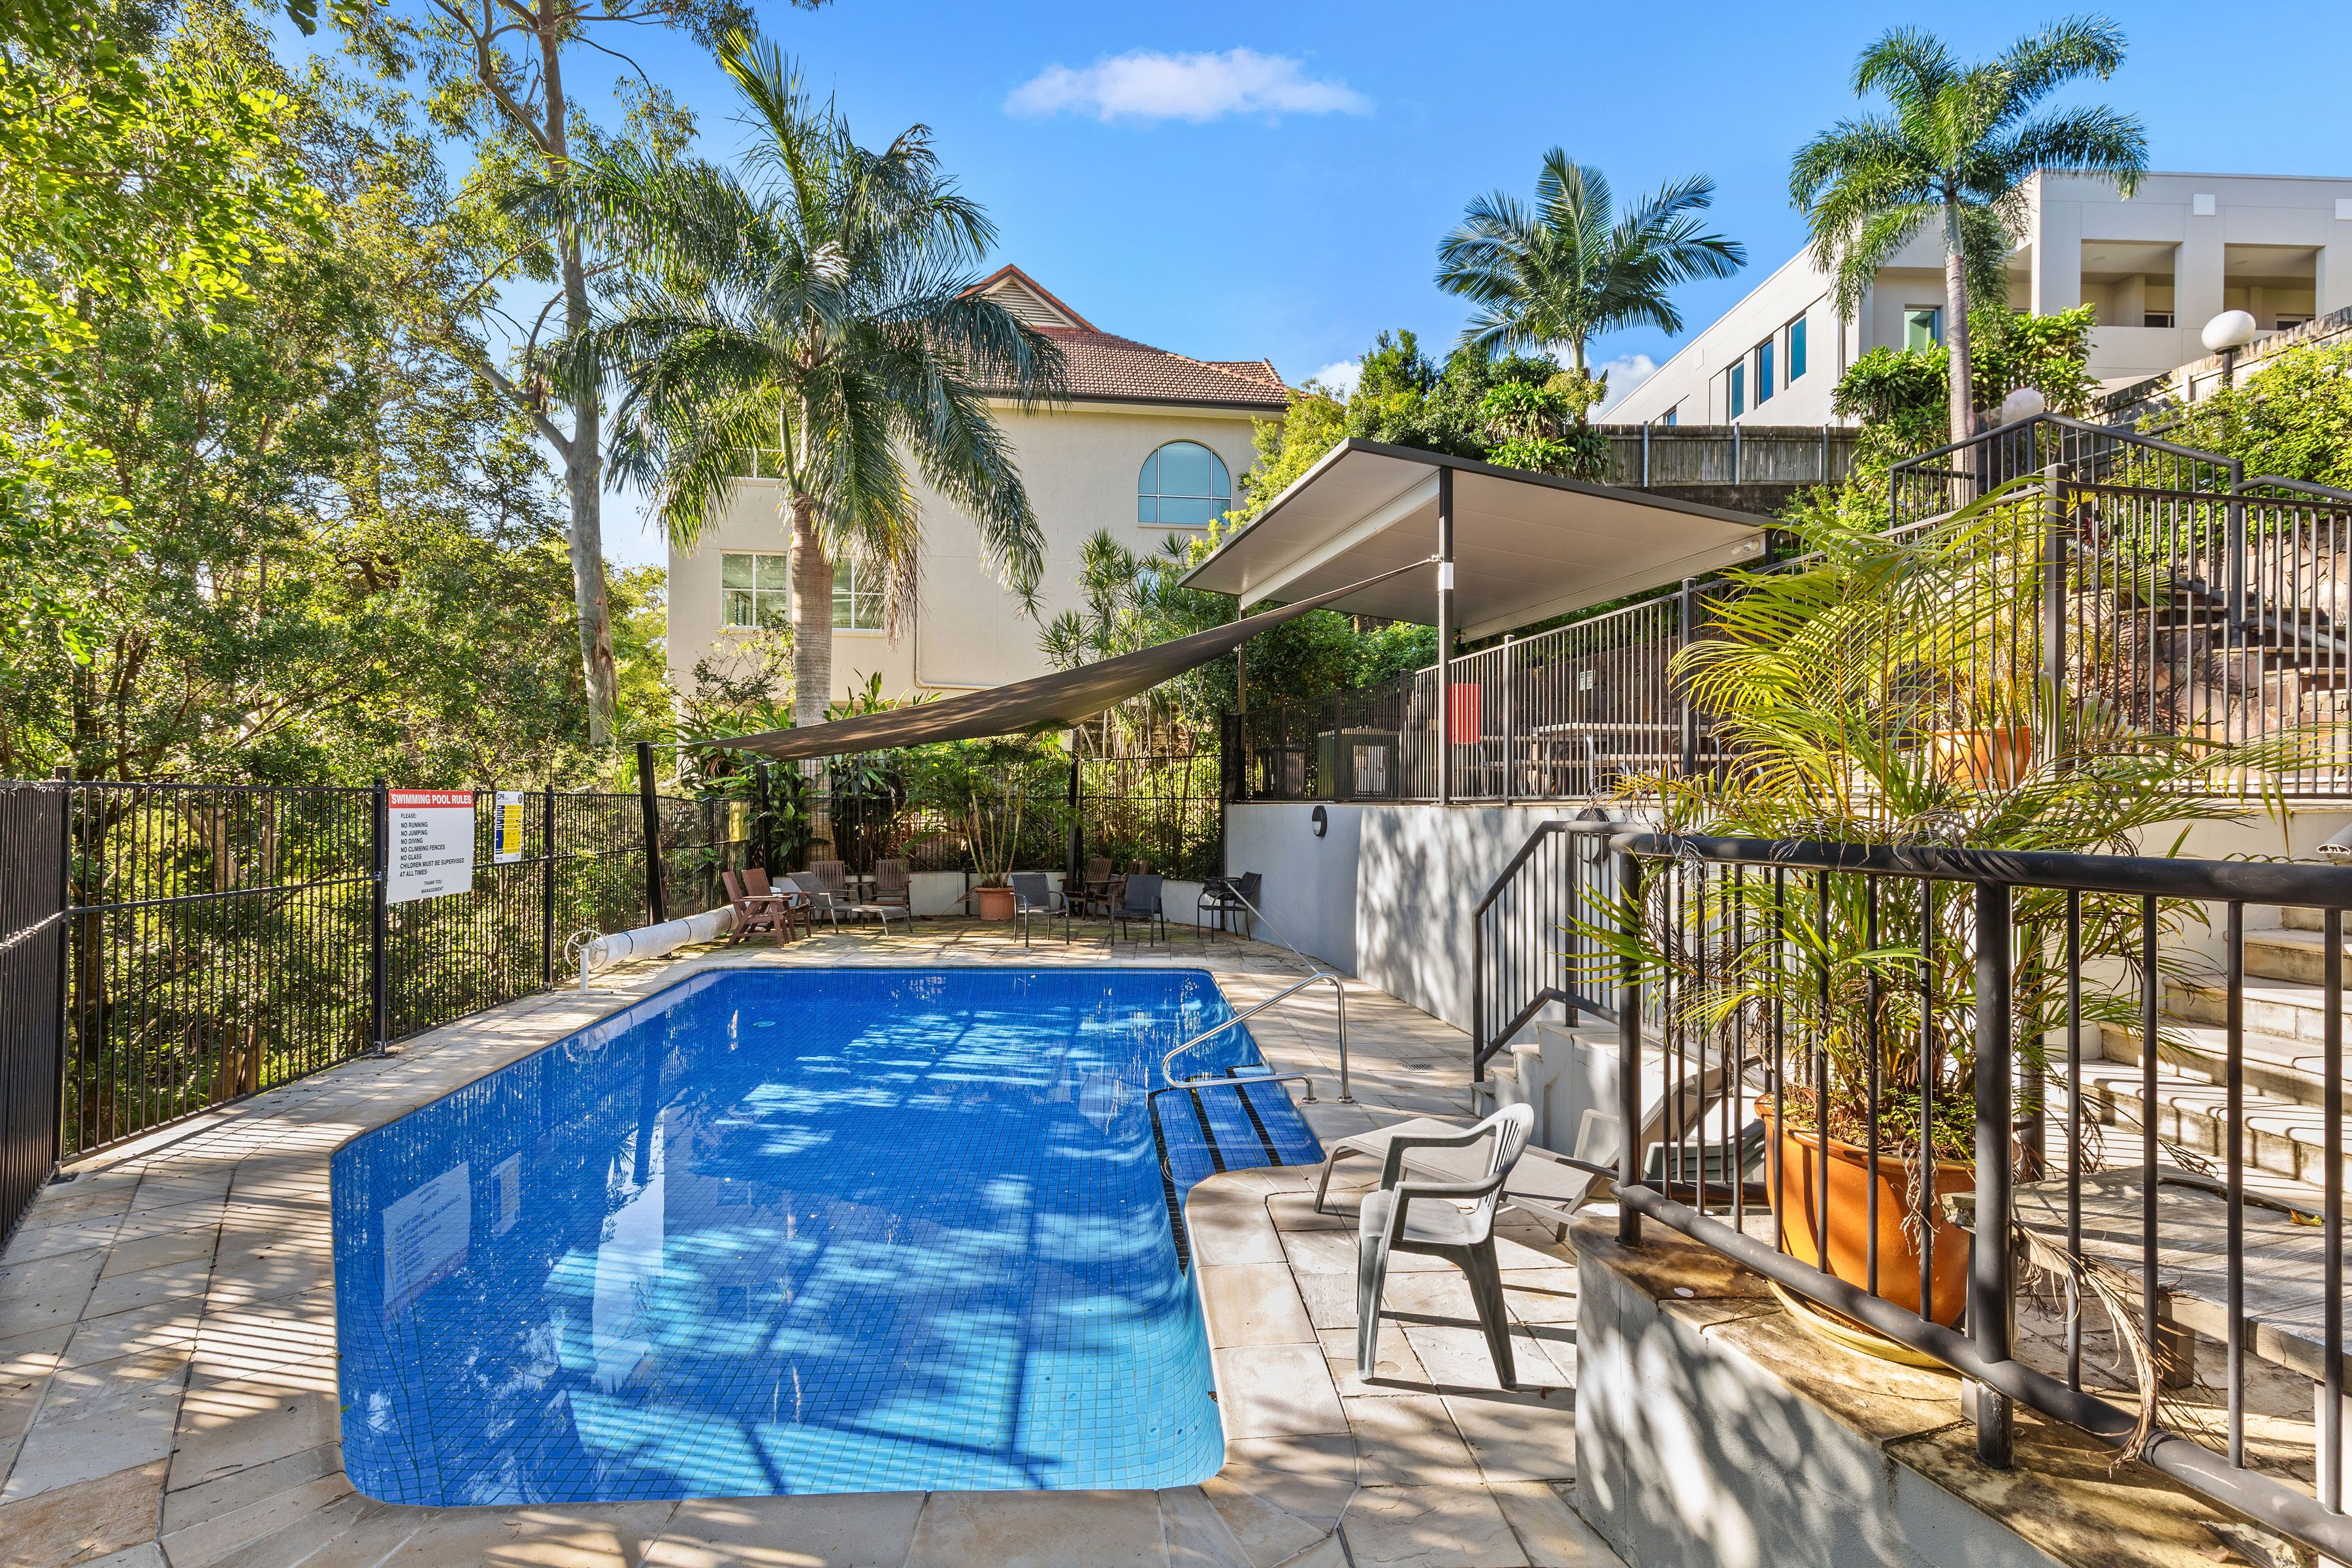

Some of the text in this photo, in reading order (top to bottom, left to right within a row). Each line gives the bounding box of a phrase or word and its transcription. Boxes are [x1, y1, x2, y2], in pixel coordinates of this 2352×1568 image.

[391, 794, 472, 804] SWIMMING POOL RULES
